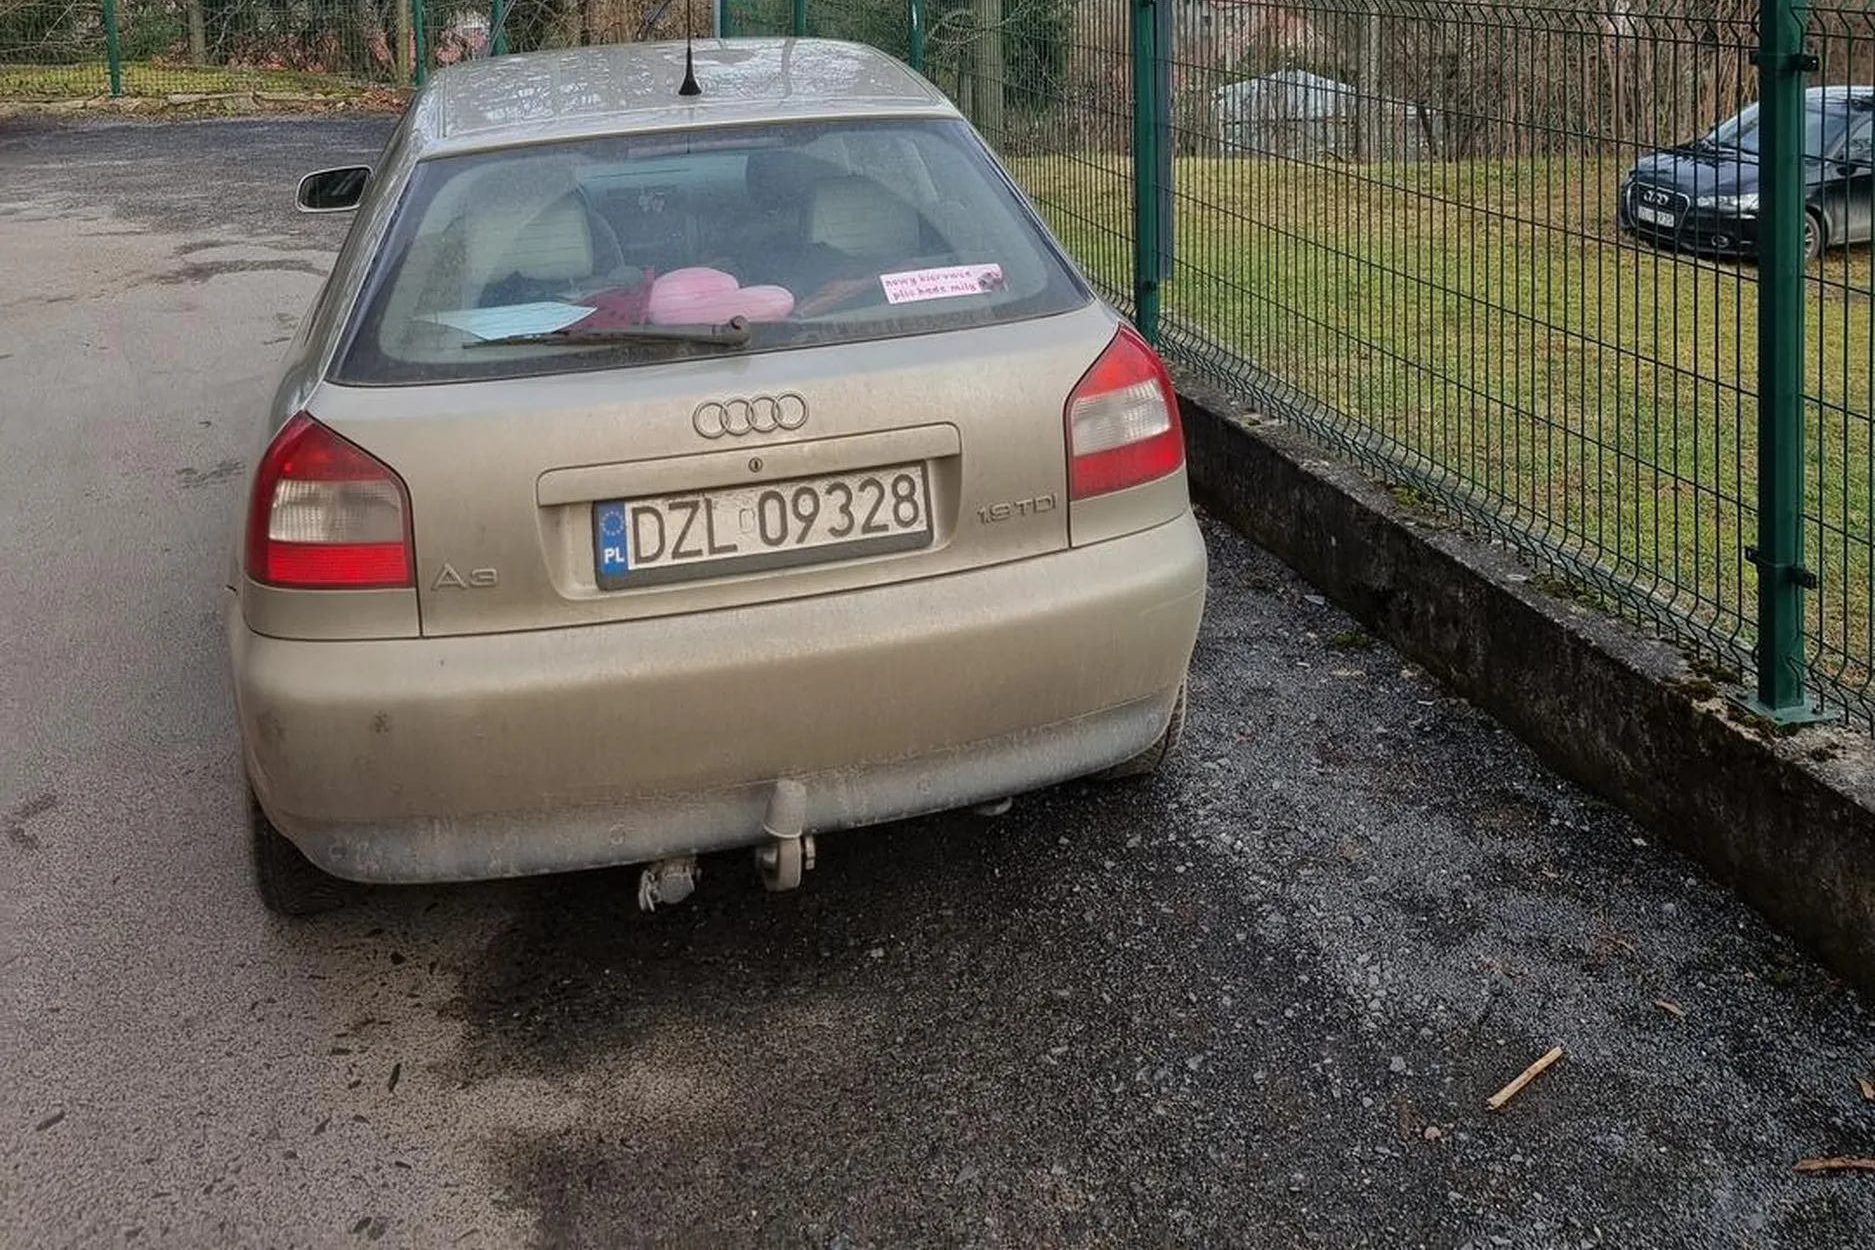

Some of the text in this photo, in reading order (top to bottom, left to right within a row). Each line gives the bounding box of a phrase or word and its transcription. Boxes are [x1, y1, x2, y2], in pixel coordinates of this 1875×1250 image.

[1014, 492, 1057, 515] TDI
[631, 474, 919, 564] DZL 09328
[604, 547, 625, 564] PL
[430, 562, 498, 591] A3
